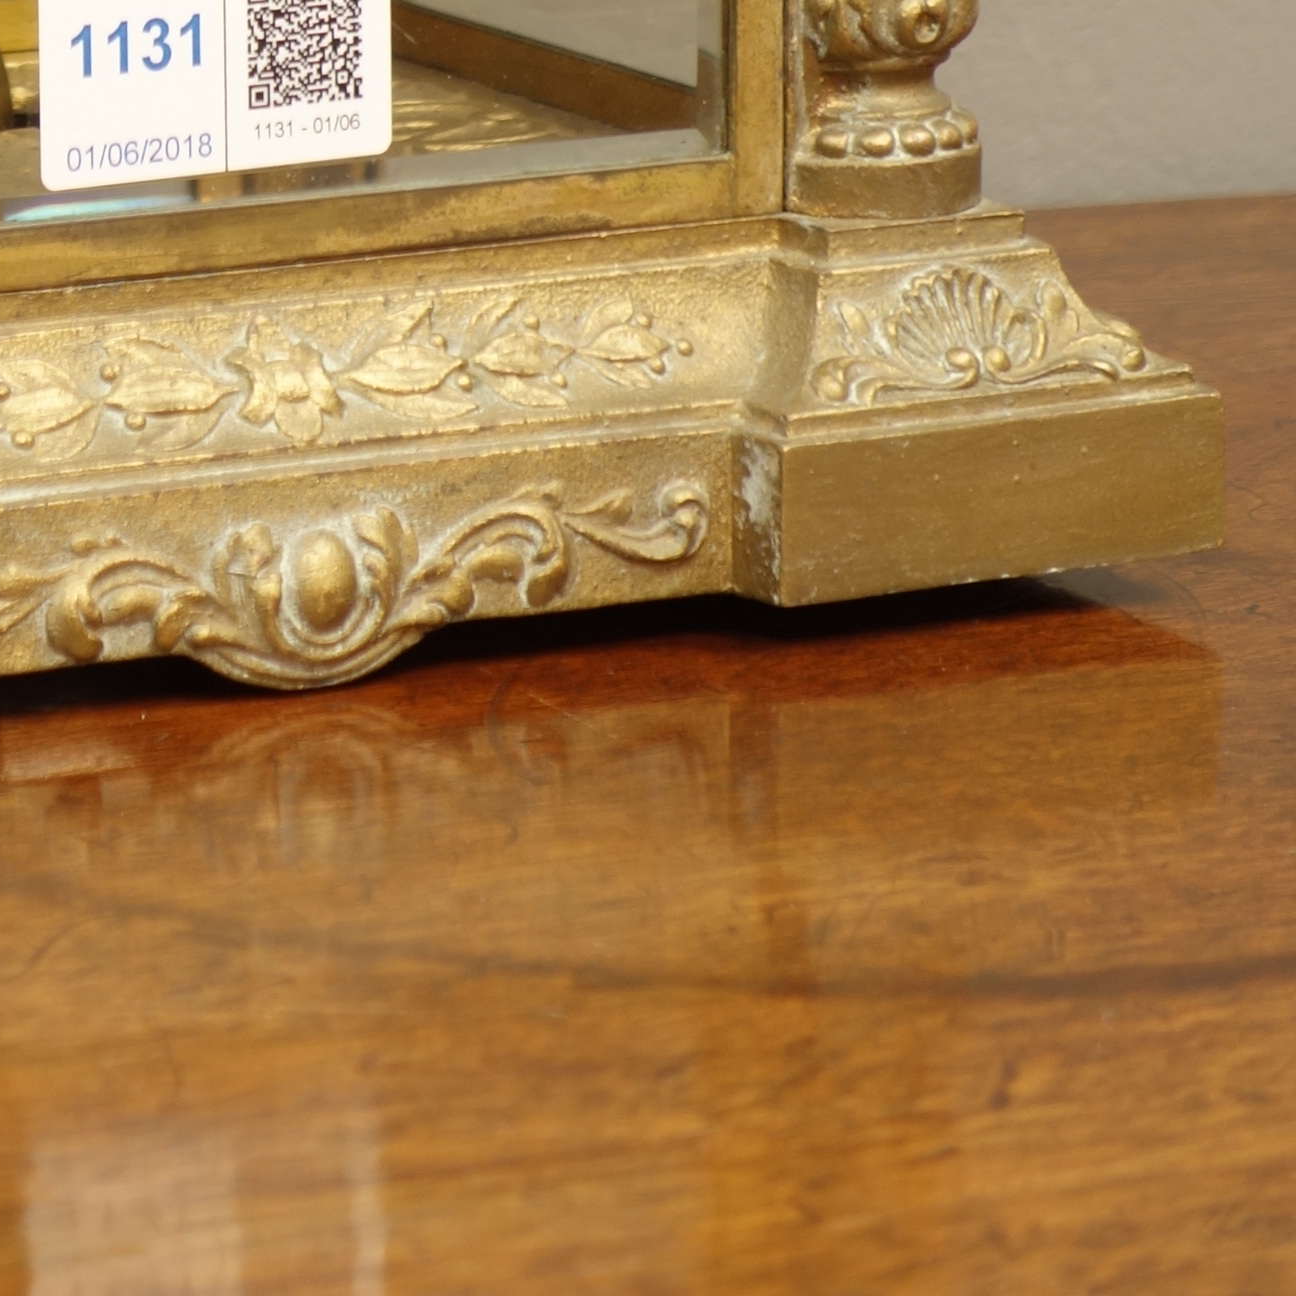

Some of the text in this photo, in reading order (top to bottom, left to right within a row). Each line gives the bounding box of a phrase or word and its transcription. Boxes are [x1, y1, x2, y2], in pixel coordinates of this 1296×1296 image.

[70, 13, 202, 78] 1131
[254, 119, 293, 141] 1131
[313, 113, 361, 135] 01/06
[66, 132, 213, 172] 01/06/2018
